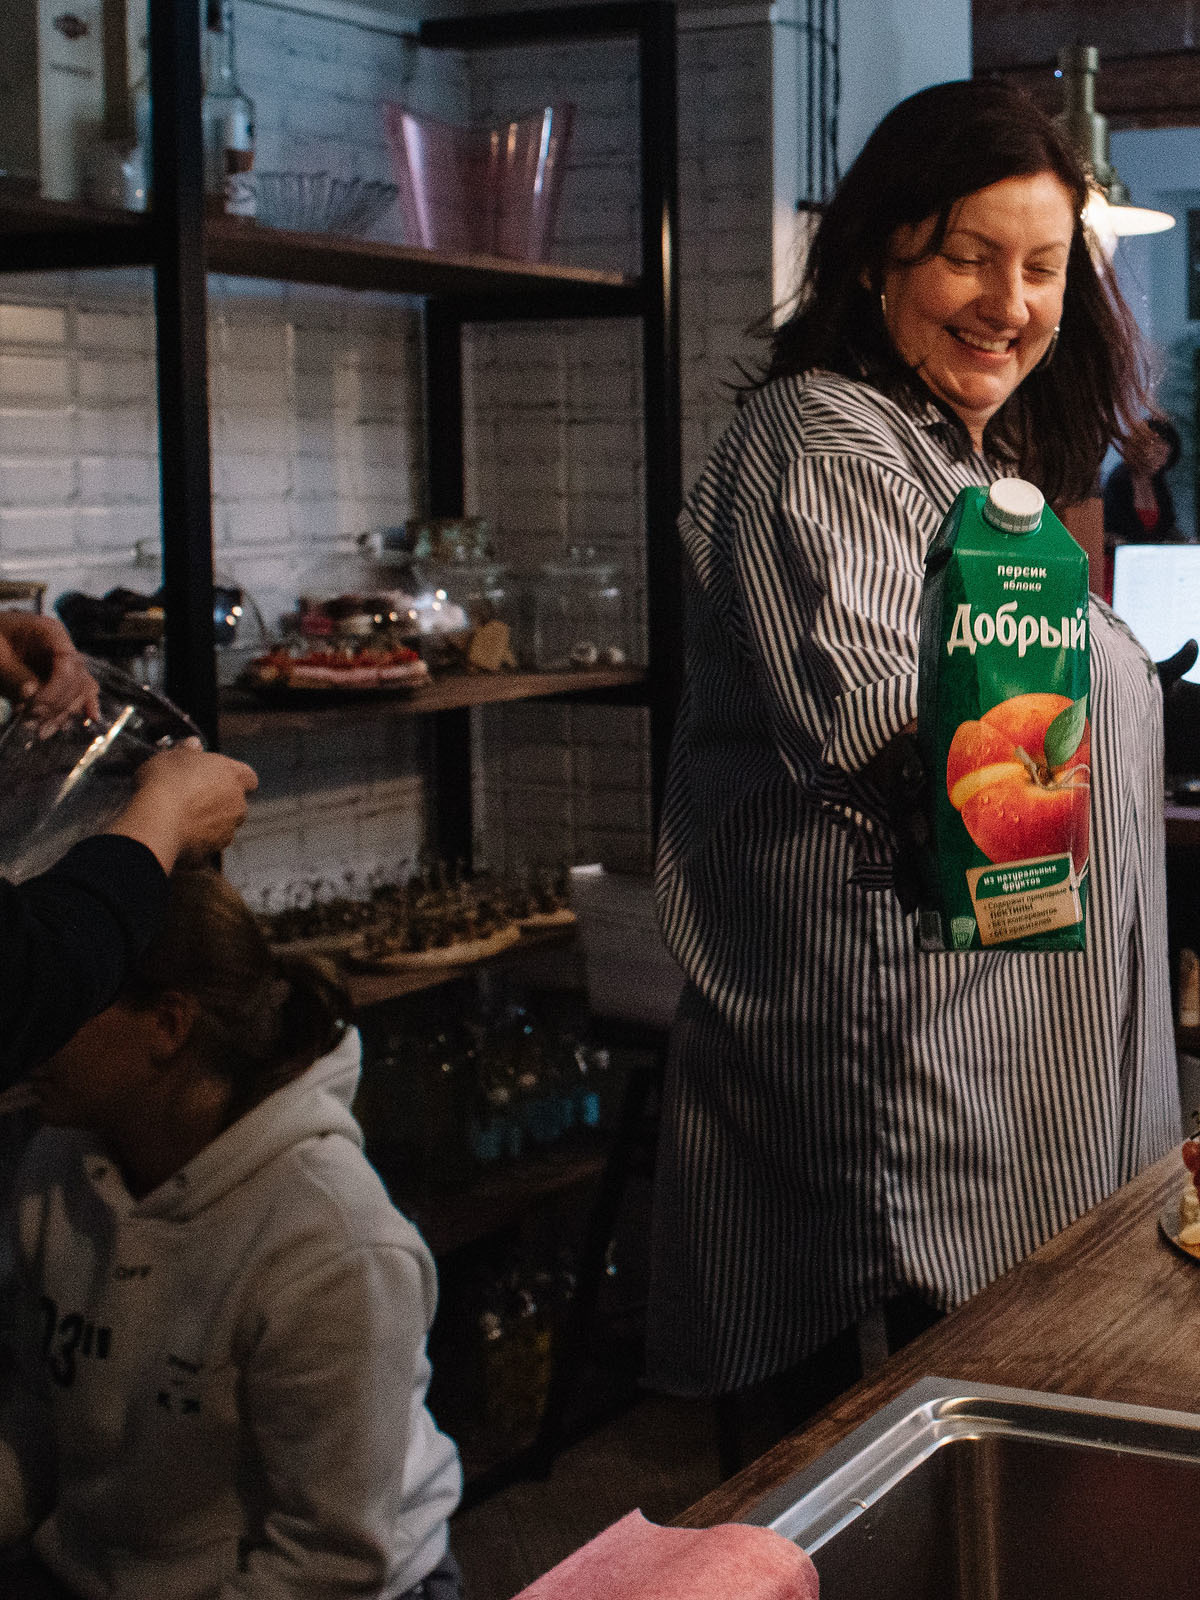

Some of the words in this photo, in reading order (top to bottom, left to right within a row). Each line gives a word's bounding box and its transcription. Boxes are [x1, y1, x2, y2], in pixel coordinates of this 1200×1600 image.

[997, 565, 1047, 579] персик
[1003, 579, 1042, 592] яблоко
[946, 600, 1087, 658] Добрый
